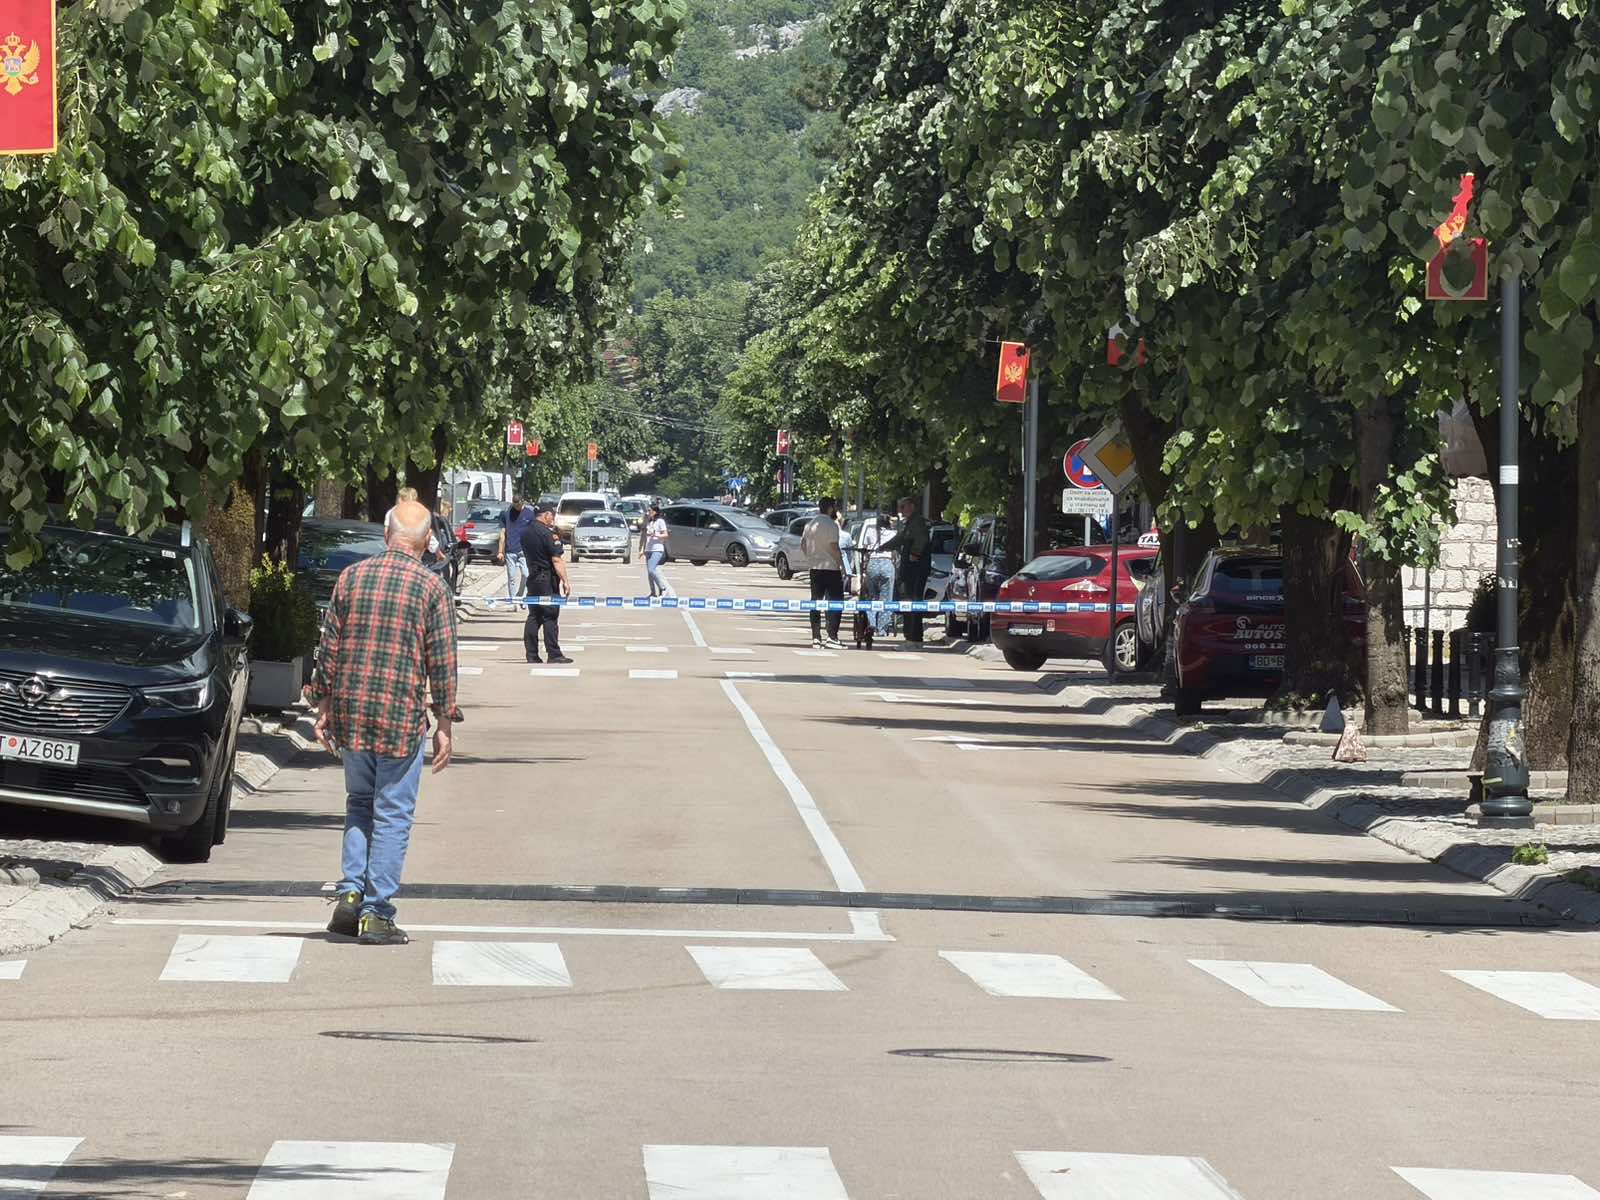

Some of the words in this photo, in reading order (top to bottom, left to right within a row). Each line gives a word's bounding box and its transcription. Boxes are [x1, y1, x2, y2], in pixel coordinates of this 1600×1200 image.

[1141, 535, 1160, 543] TAX
[1233, 629, 1287, 640] AUTOS
[17, 738, 75, 762] AZ661
